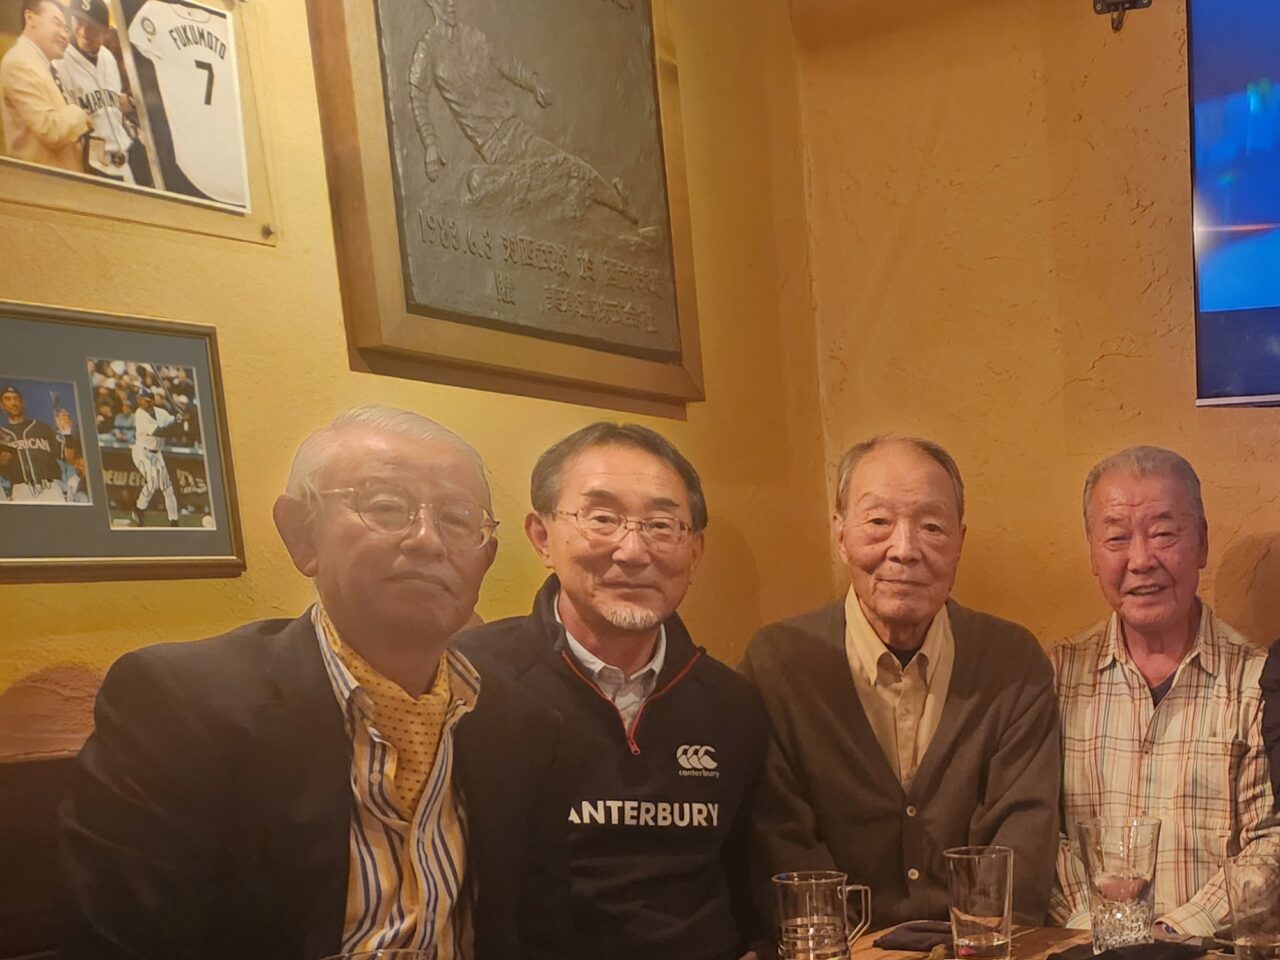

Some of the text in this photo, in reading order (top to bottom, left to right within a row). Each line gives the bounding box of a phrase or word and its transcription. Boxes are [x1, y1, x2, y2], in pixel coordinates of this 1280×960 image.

[169, 25, 227, 60] FUKUMOTO
[194, 60, 214, 105] 7
[678, 769, 719, 778] canterbury
